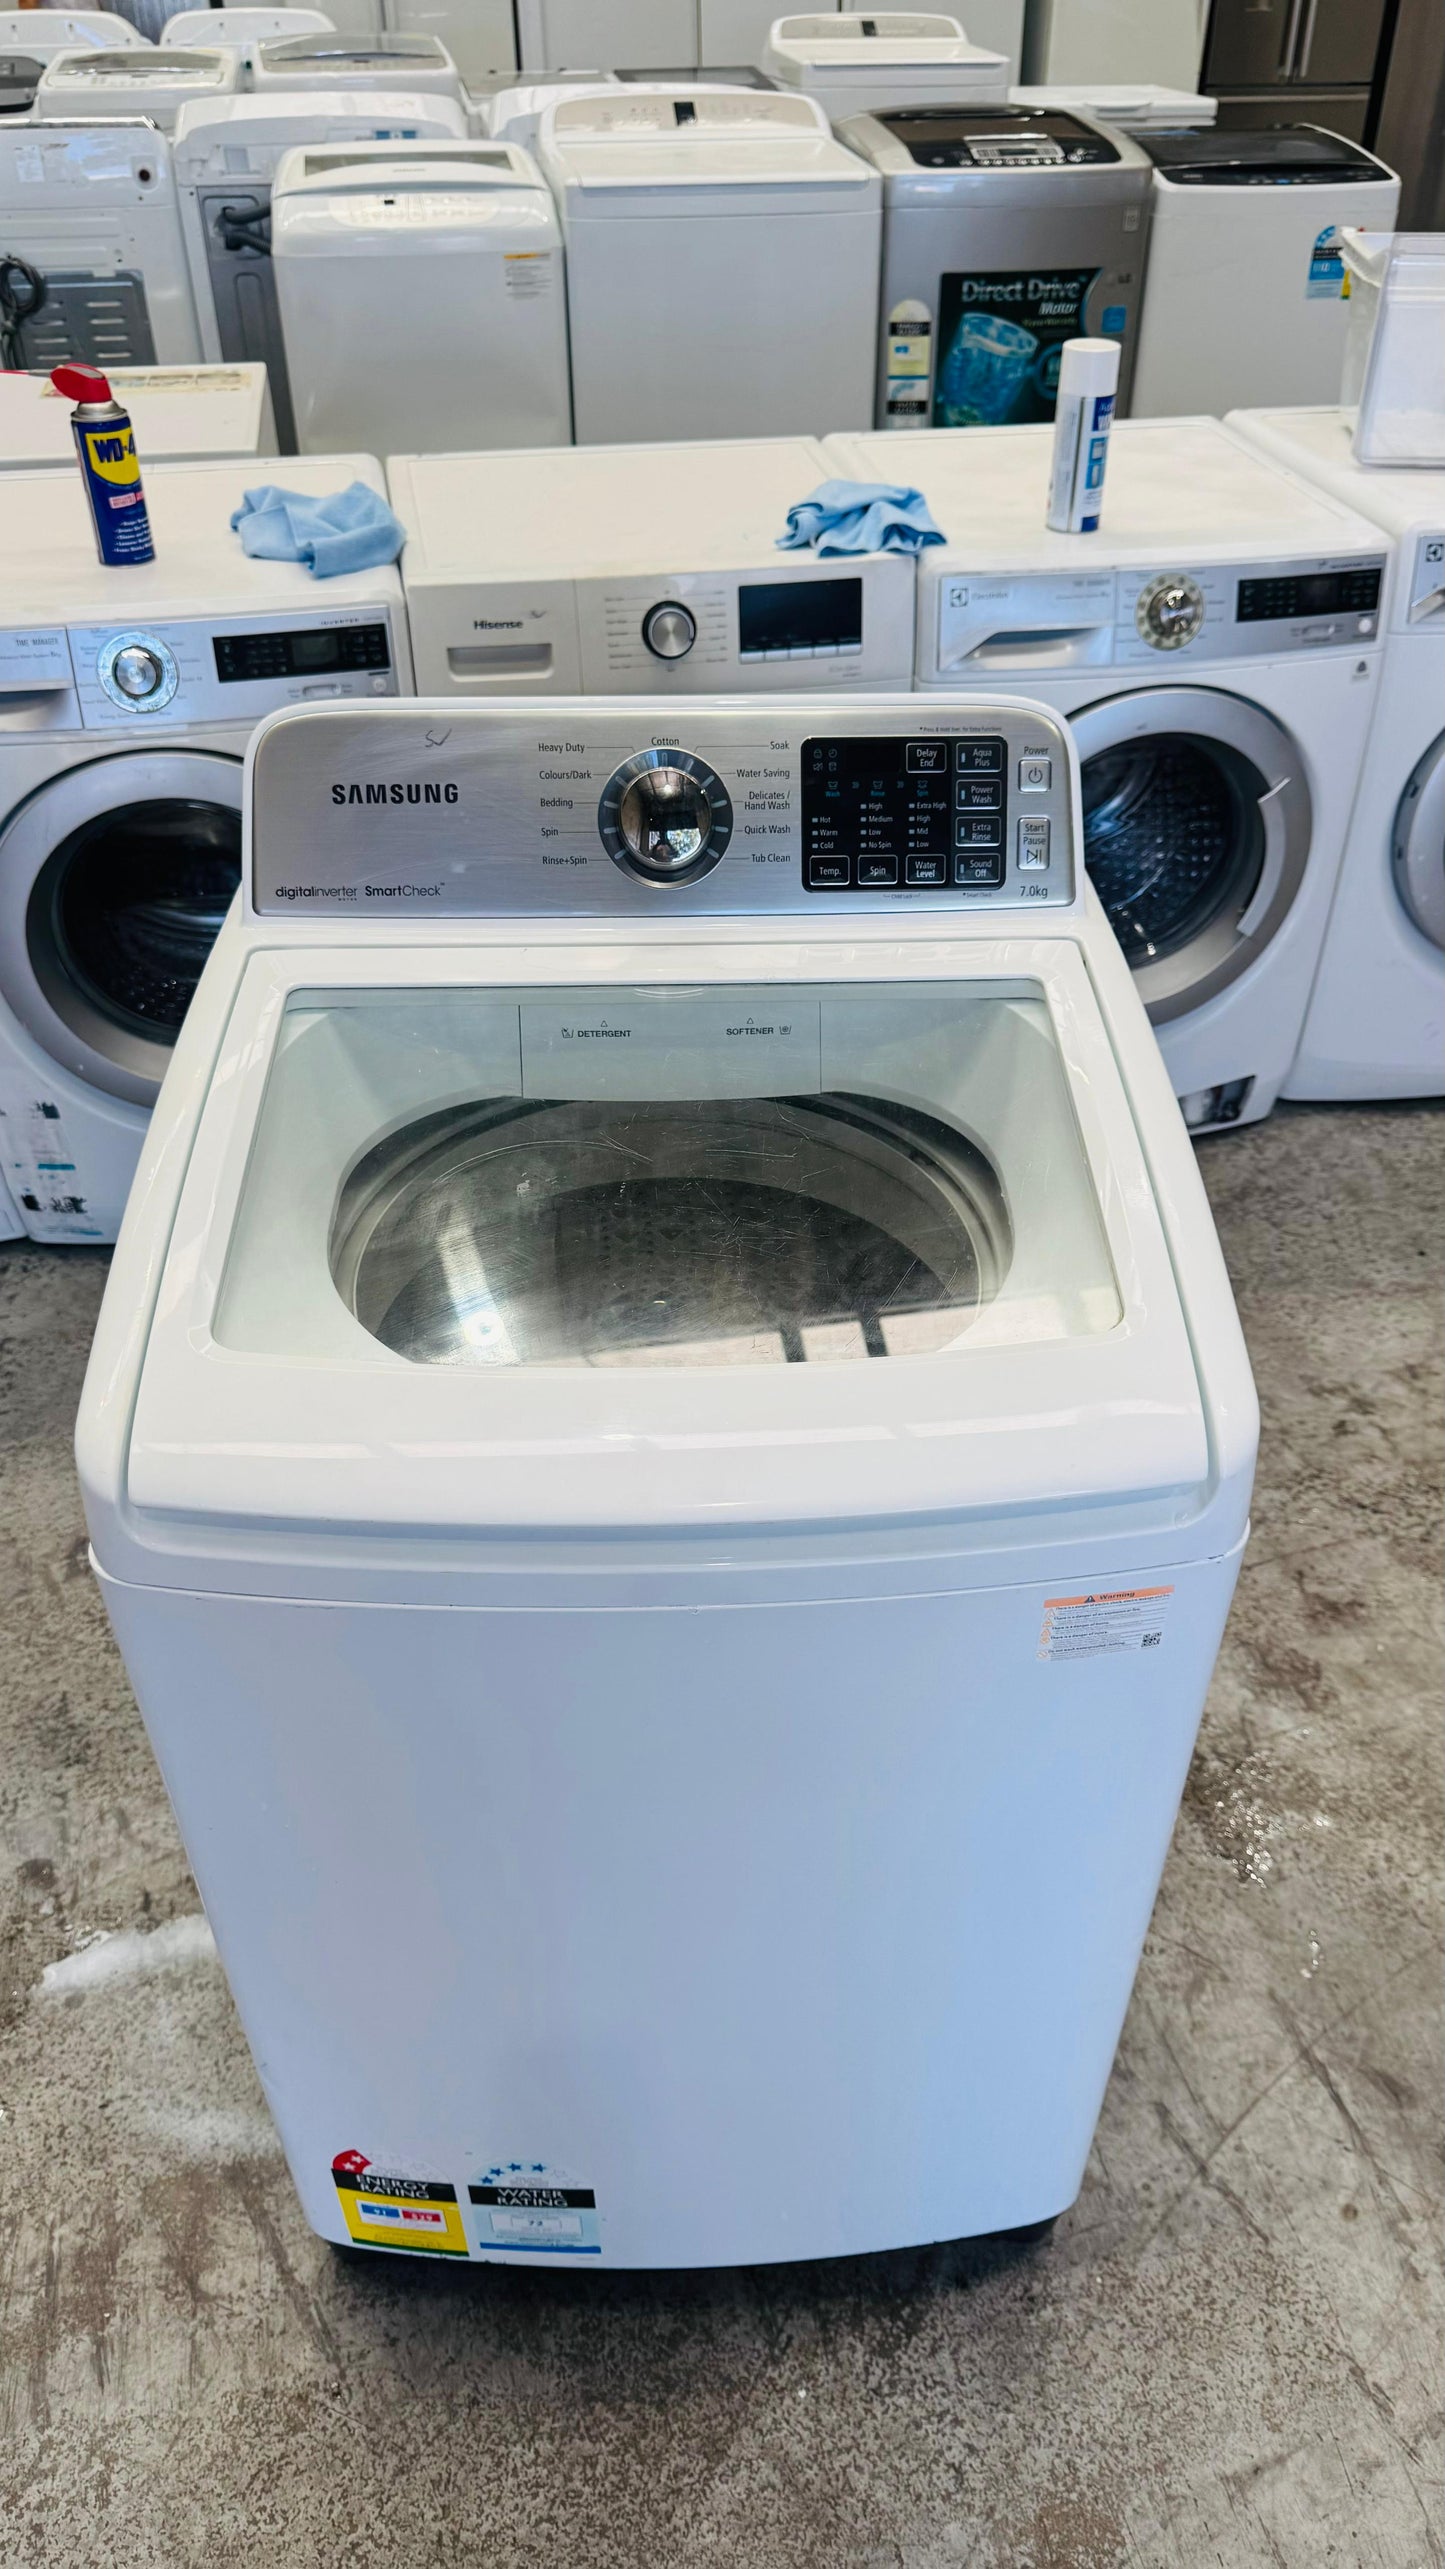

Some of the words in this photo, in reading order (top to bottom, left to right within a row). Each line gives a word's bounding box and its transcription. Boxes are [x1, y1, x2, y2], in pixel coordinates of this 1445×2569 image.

[962, 279, 1024, 301] Direct
[1027, 278, 1080, 300] Drive
[1039, 301, 1079, 315] Motor
[474, 620, 523, 630] Hisense
[651, 737, 680, 746] Cotton
[770, 741, 790, 750] Soak
[538, 743, 564, 754] Heavy
[565, 743, 585, 754] Duty
[972, 748, 993, 758] Aqua
[1023, 746, 1049, 755] Power
[916, 748, 938, 760] Delay
[920, 758, 935, 767] End
[974, 758, 991, 767] Plus
[539, 769, 592, 780] Colours/Dark
[736, 769, 761, 778] Water
[763, 768, 790, 779] Saving
[332, 783, 459, 805] SAMSUNG
[970, 785, 994, 794] Power
[748, 791, 785, 800] Delicates
[972, 794, 993, 804] Wash
[540, 797, 574, 810] Bedding
[744, 801, 766, 811] Hand
[767, 800, 791, 810] Wash
[868, 803, 883, 811] High
[917, 802, 932, 810] Extra
[933, 802, 947, 811] High
[820, 816, 831, 824] Hot
[868, 815, 894, 823] Medium
[917, 815, 931, 824] High
[744, 825, 767, 835] Quick
[768, 824, 791, 834] Wash
[917, 827, 929, 835] Mid
[971, 822, 992, 832] Extra
[1025, 823, 1045, 833] Start
[541, 826, 559, 839] Spin
[820, 829, 839, 837] Warm
[971, 832, 992, 841] Rinse
[868, 841, 878, 849] No
[878, 840, 892, 850] Spin
[917, 840, 930, 848] Low
[1023, 836, 1047, 845] Pause
[542, 855, 588, 867] Rinse+Spin
[752, 853, 767, 863] Tub
[767, 853, 791, 863] Clean
[915, 861, 937, 870] Water
[969, 859, 993, 869] Sound
[819, 866, 842, 877] Temp.
[870, 866, 887, 877] Spin
[916, 869, 936, 878] Level
[974, 868, 988, 878] Off
[275, 885, 358, 901] digitalinverter
[1020, 885, 1048, 899] 7.0kg
[577, 1029, 632, 1038] DETERGENT
[726, 1026, 774, 1036] SOFTENER
[1099, 1592, 1135, 1601] Warning
[356, 2174, 429, 2191] ENERGY
[360, 2183, 430, 2199] RATING
[498, 2188, 564, 2199] WATER
[497, 2197, 568, 2208] RATING
